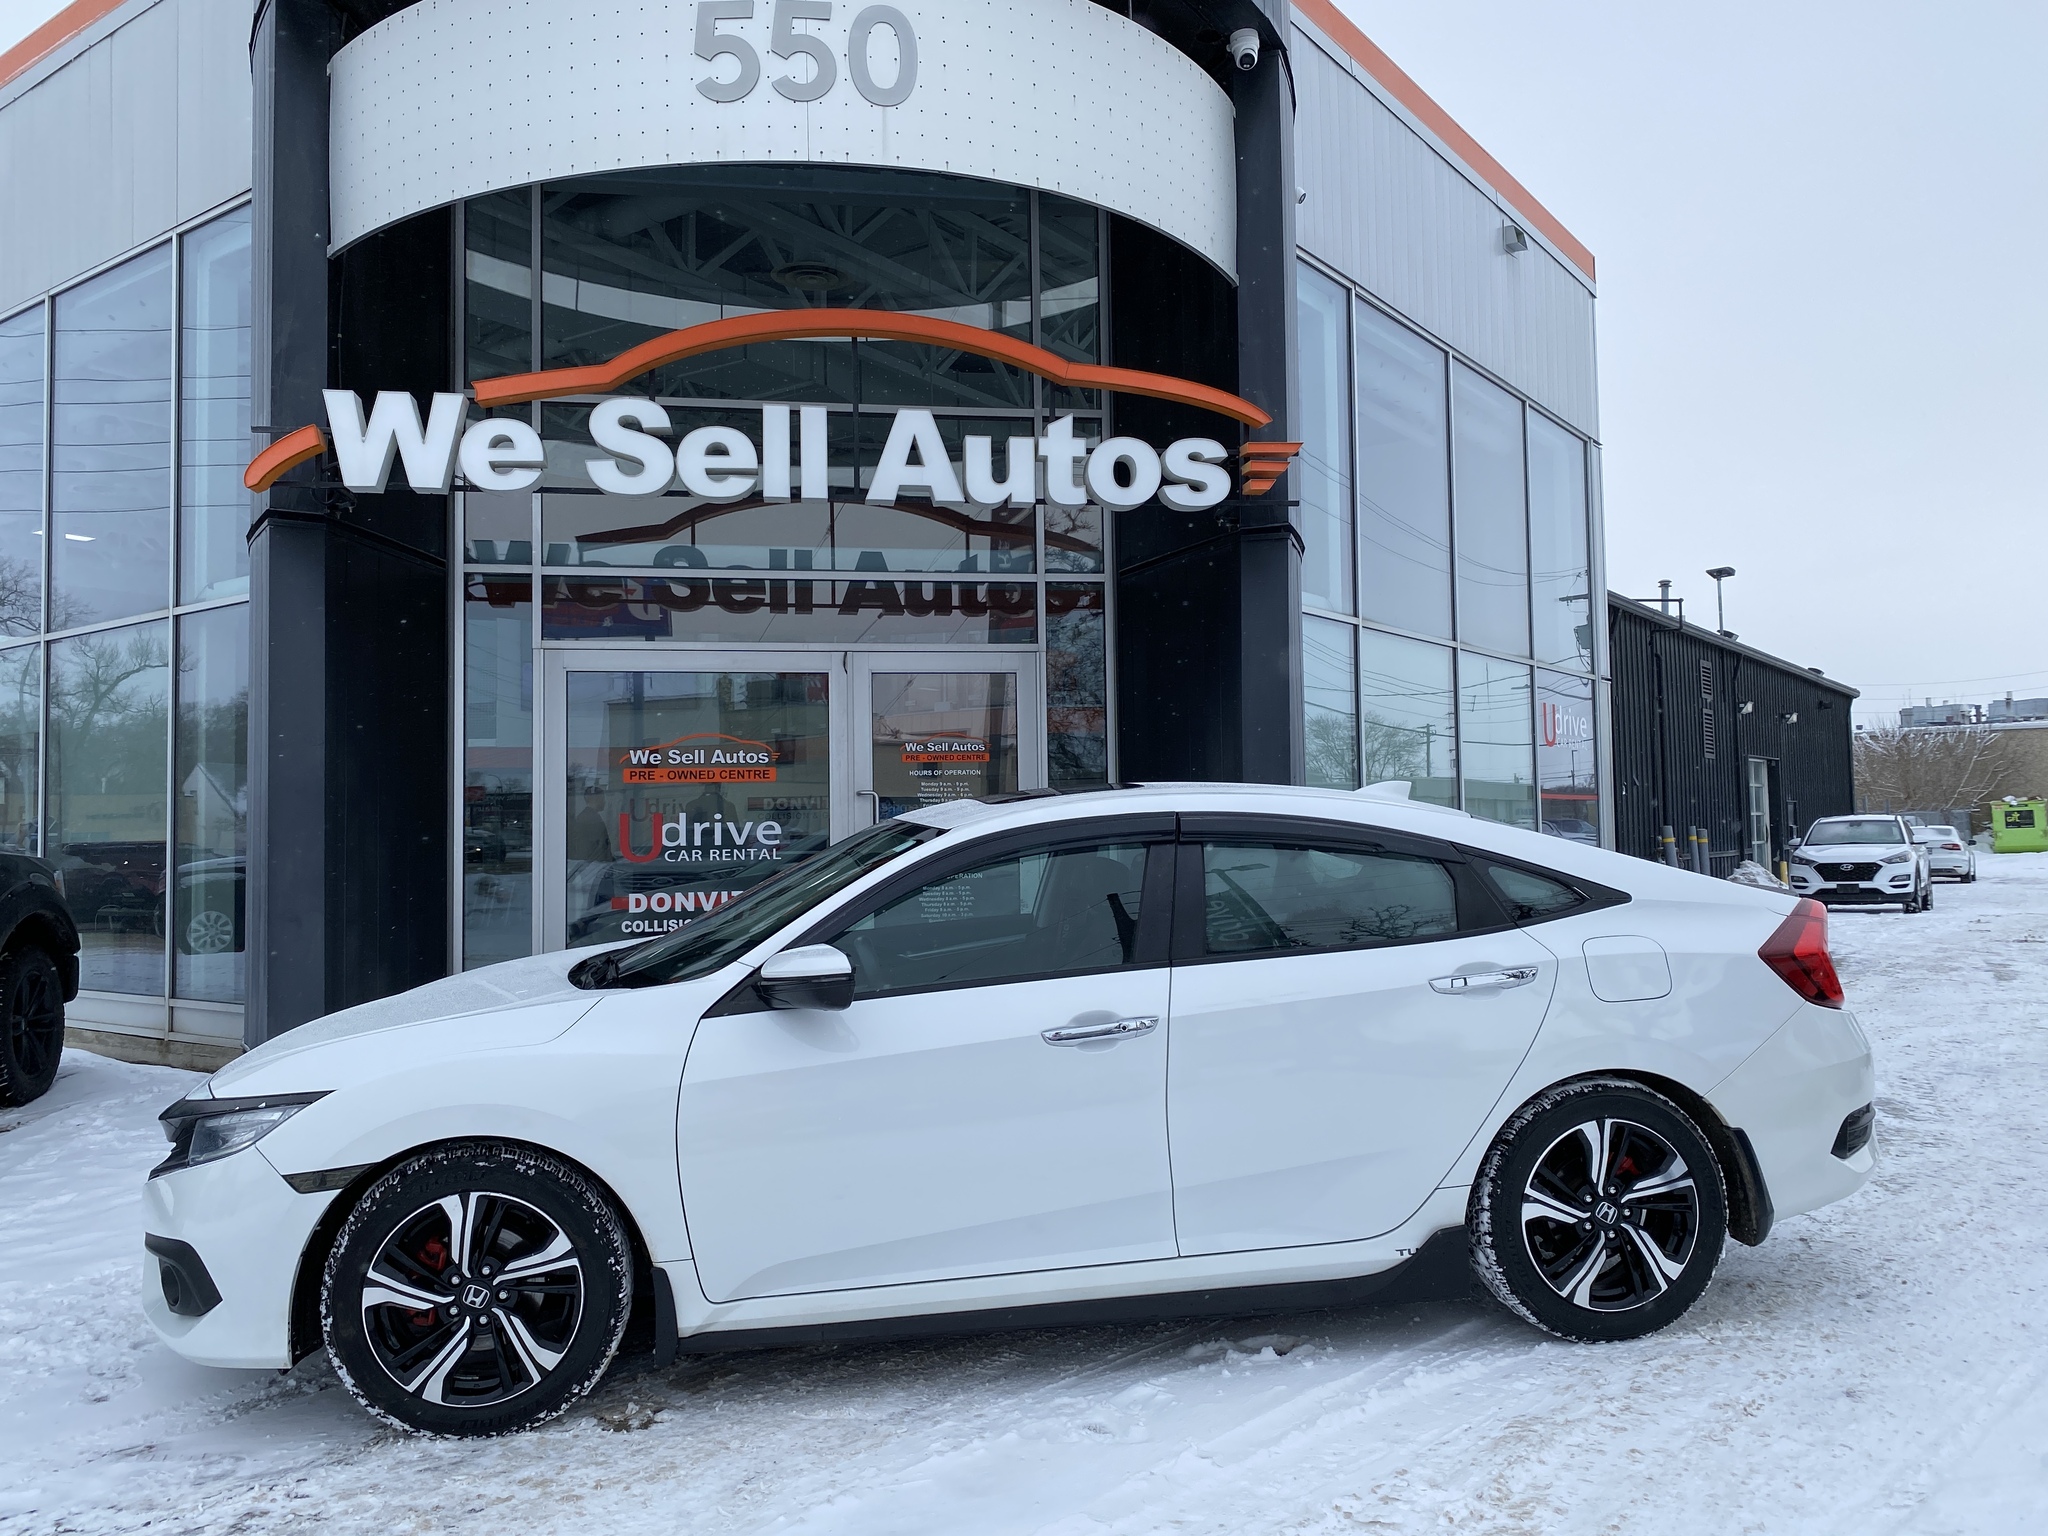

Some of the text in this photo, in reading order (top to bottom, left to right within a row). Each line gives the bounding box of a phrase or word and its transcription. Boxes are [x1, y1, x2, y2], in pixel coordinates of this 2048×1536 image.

[694, 0, 918, 107] 550
[322, 388, 1231, 512] We Sell Autos
[1543, 702, 1587, 747] Udrive
[630, 749, 769, 765] We Sell Autos
[905, 742, 986, 752] We Sell Autos
[629, 770, 655, 780] PRE
[667, 769, 715, 780] OWNED
[719, 769, 770, 780] CENTRE
[619, 812, 782, 863] Udrive
[664, 848, 782, 862] CAR RENTAL
